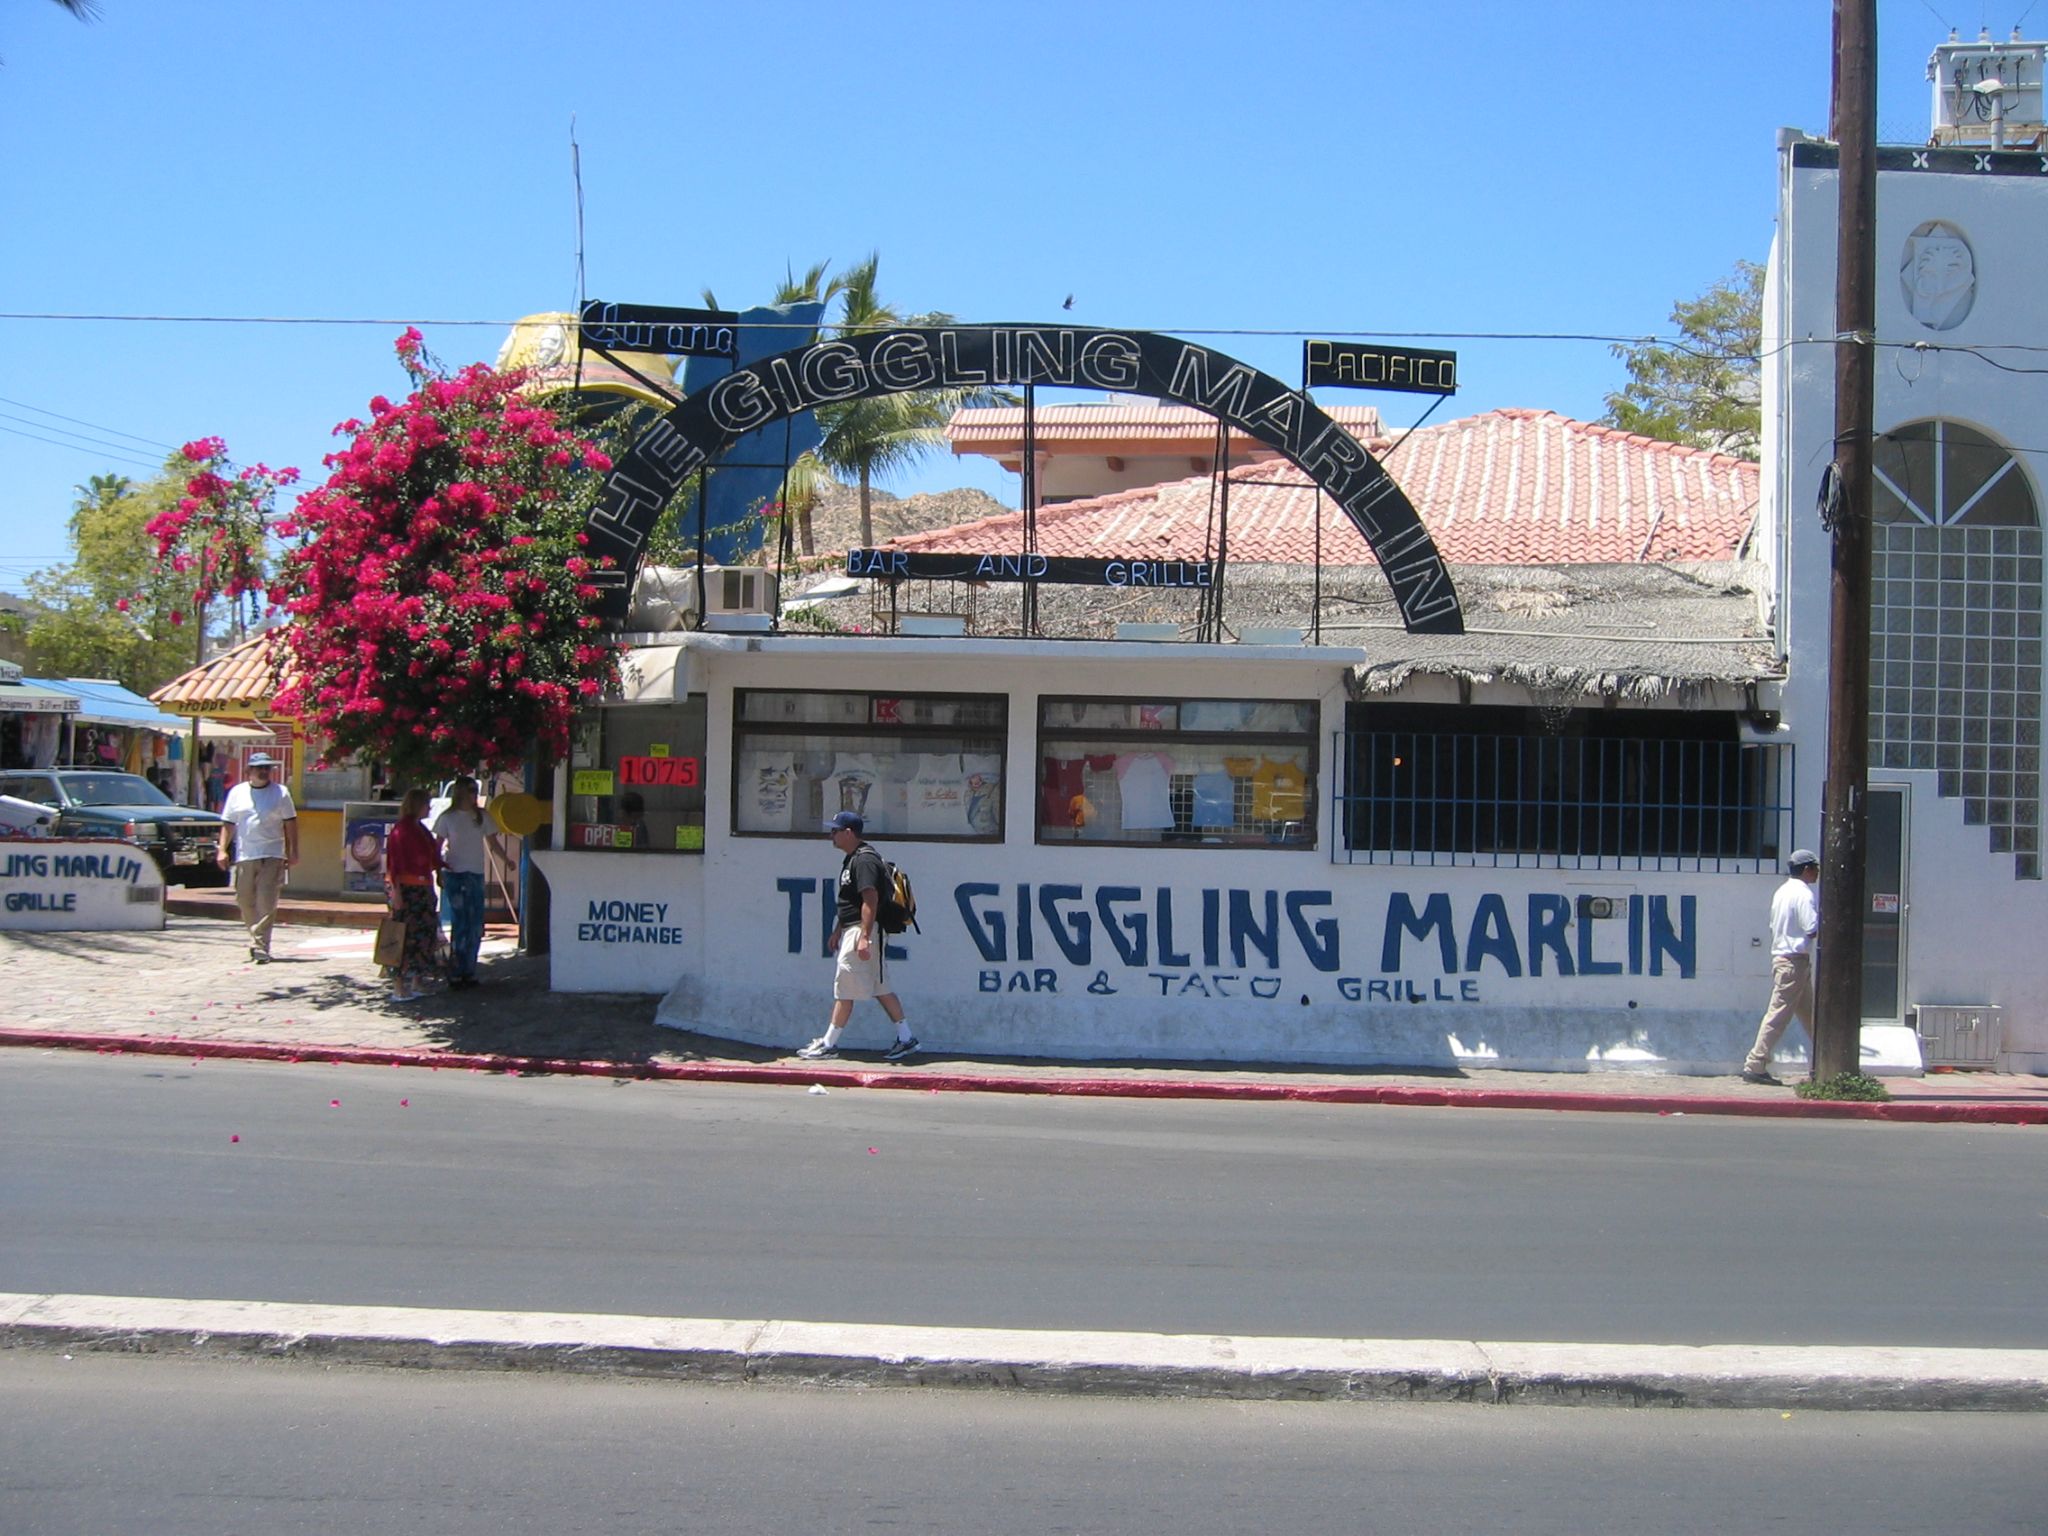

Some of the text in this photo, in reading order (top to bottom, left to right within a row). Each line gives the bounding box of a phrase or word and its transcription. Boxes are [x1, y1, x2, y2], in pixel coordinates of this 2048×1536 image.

[708, 329, 1142, 432] GIGGLING
[1168, 344, 1458, 627] MARLIN
[847, 549, 1212, 588] BAR AND GRILLE
[625, 759, 694, 785] 1075
[54, 854, 142, 884] MARLIN
[5, 892, 77, 912] GRILLE
[588, 900, 669, 924] MONEY
[577, 922, 683, 945] EXCHANGE
[953, 881, 1341, 973] GIGGLING
[1380, 891, 1697, 980] MARLIN
[978, 967, 1480, 1003] BAR & TACO GRILLE
